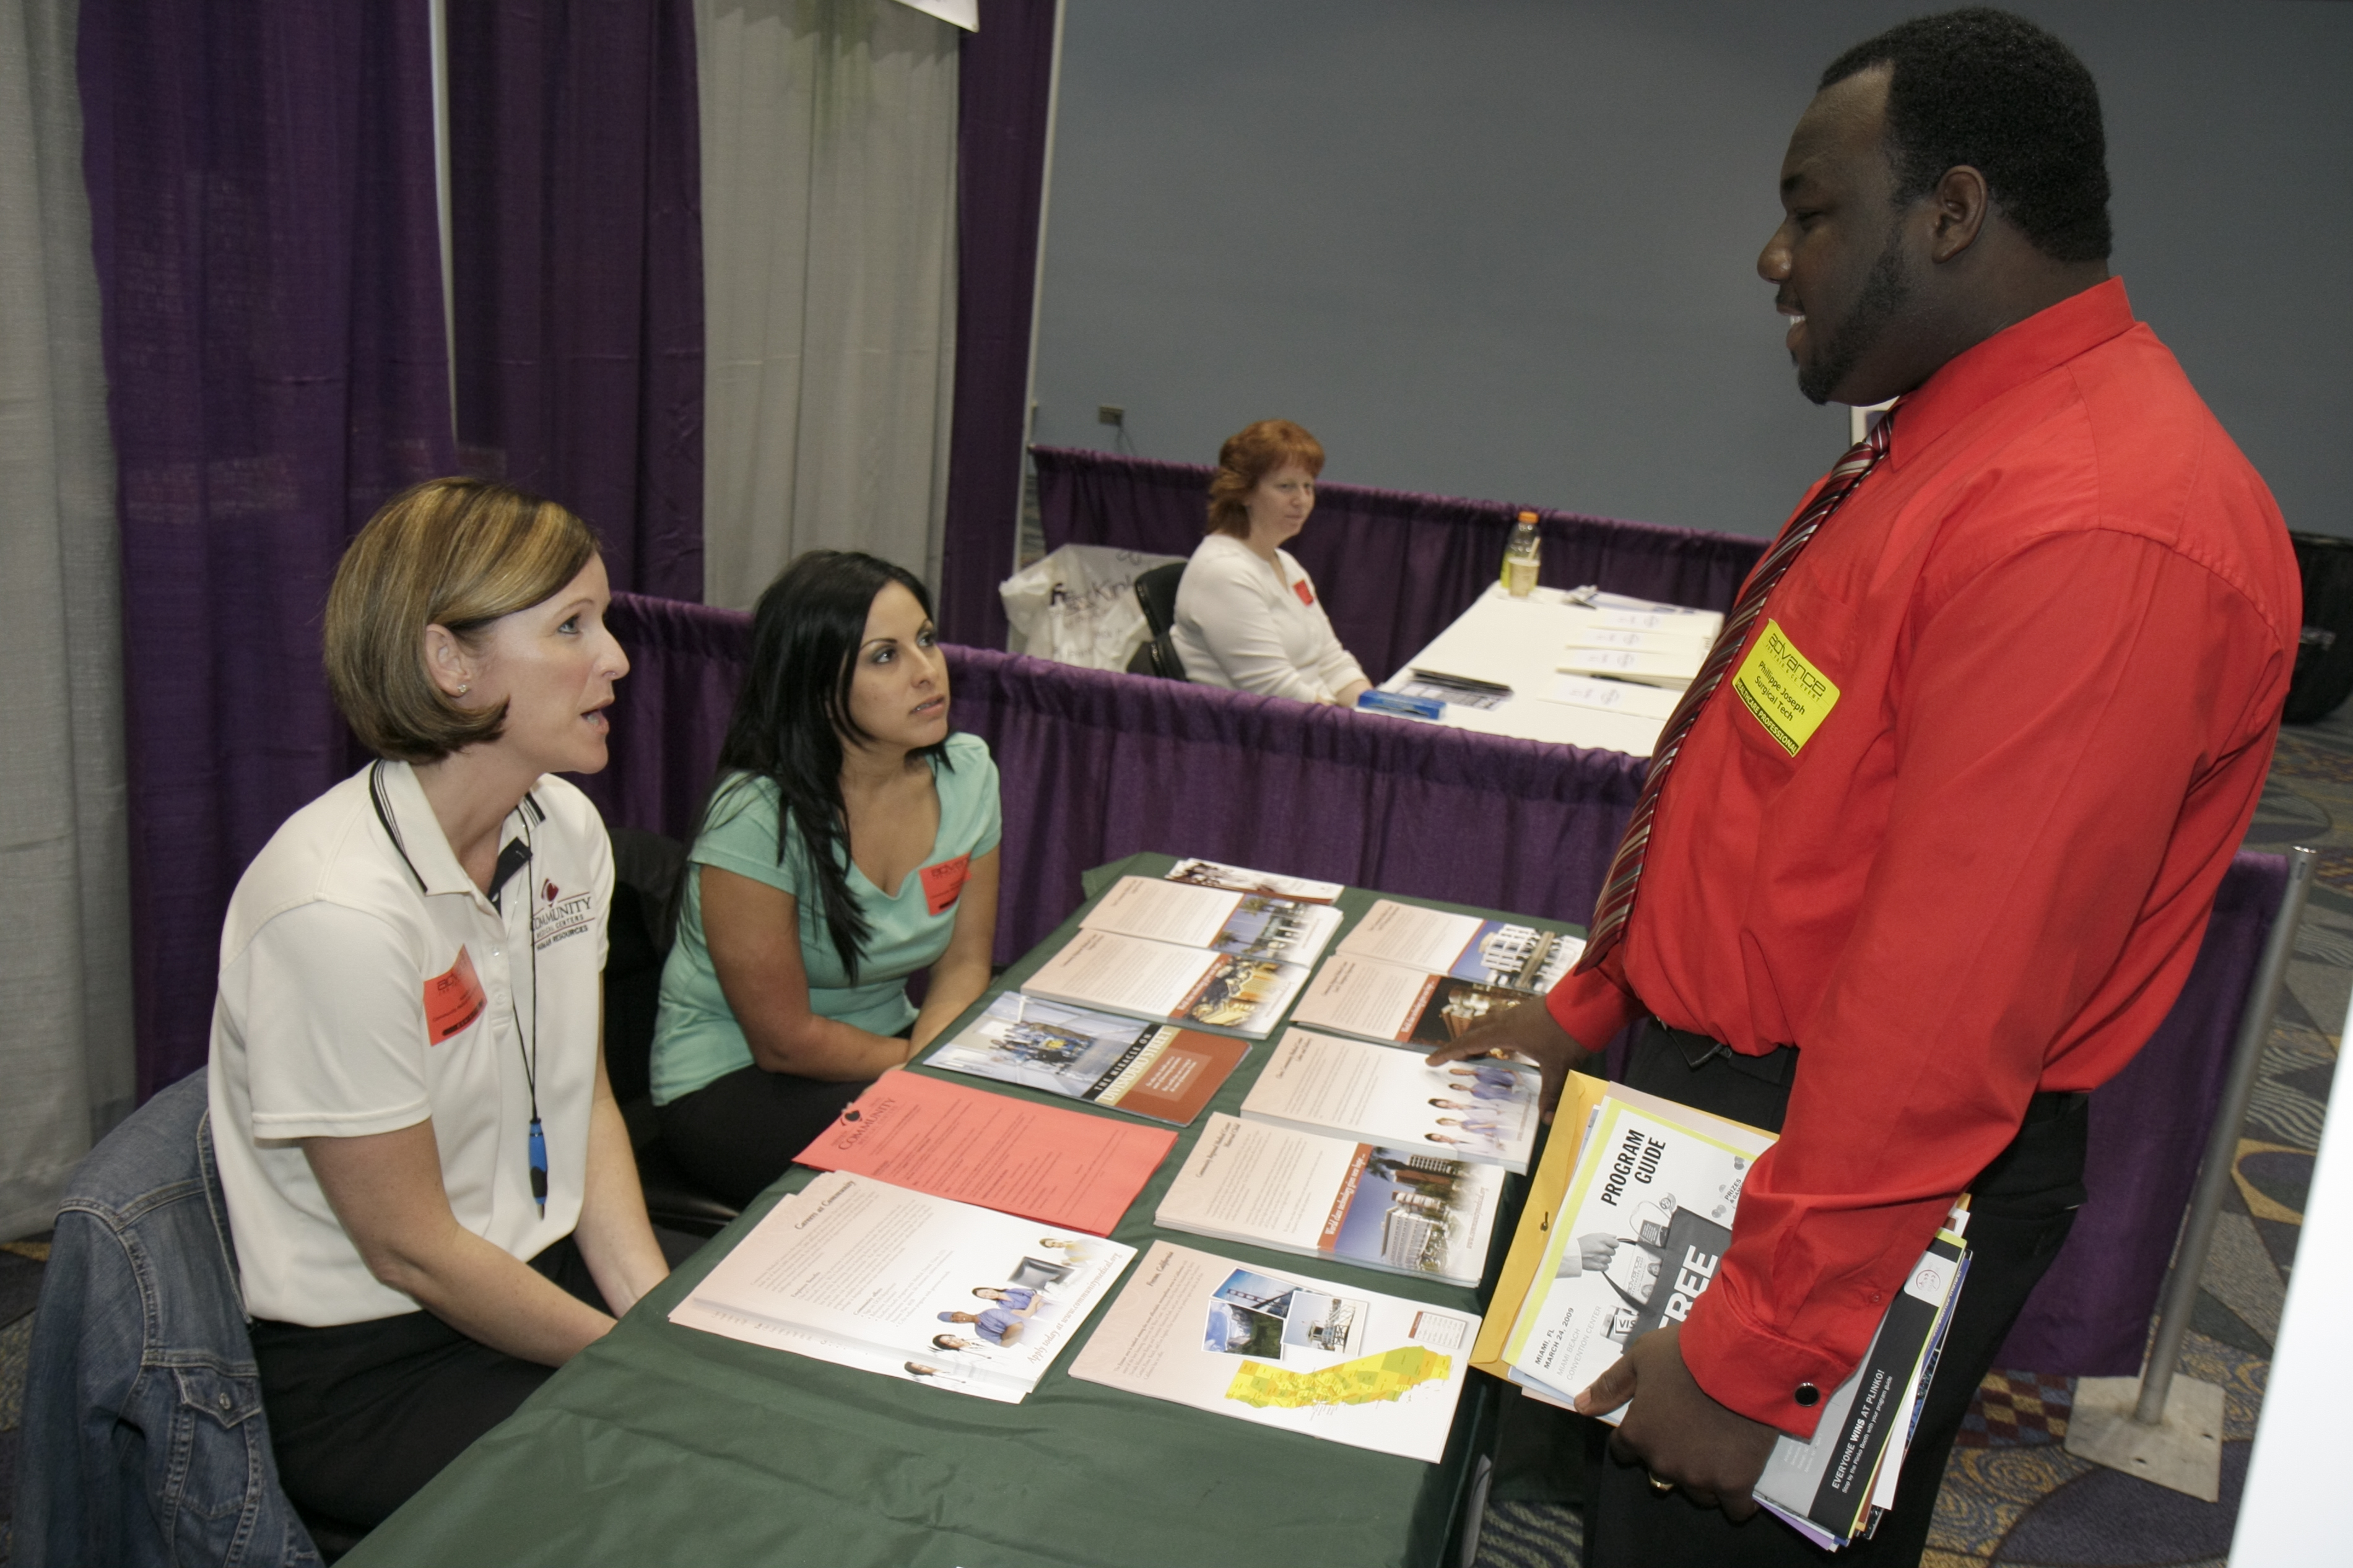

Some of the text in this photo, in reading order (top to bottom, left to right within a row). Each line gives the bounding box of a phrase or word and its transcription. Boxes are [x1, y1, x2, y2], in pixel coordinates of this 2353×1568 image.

[1768, 633, 1826, 696] advance
[1773, 654, 1785, 669] FAIR
[1791, 674, 1798, 683] CE
[1800, 682, 1820, 703] EVENT
[1736, 680, 1798, 754] HEALTHCARE PROFESSIONAL
[1755, 675, 1793, 721] Surgical Tech
[1781, 687, 1806, 716] Joseph
[552, 925, 588, 942] RESOURCES
[1093, 1033, 1154, 1091] THE MIRACLE ON
[1099, 1055, 1149, 1101] DIVISADERO
[1139, 1029, 1173, 1057] STREET
[837, 1097, 897, 1150] COMMUNITY
[1230, 1123, 1240, 1132] Child
[1344, 1176, 1359, 1188] gives
[1350, 1167, 1359, 1177] new
[1601, 1128, 1645, 1206] PROGRAM
[1634, 1137, 1666, 1185] GUIDE
[793, 1211, 819, 1230] Careers
[819, 1179, 857, 1207] Community
[1335, 1186, 1355, 1210] technology
[1724, 1177, 1741, 1200] PRIZES
[1324, 1219, 1339, 1235] World
[1331, 1208, 1343, 1221] class
[1146, 1250, 1176, 1286] Fresno, California
[853, 1297, 874, 1315] Community
[1025, 1345, 1048, 1364] Apply
[1039, 1329, 1061, 1346] today
[1059, 1251, 1123, 1324] www.communitymedical.org
[1534, 1327, 1554, 1365] MIAMI, FL
[1544, 1306, 1574, 1369] MARCH 24, 2009
[1557, 1328, 1580, 1376] MIAMI BEACH
[1566, 1305, 1601, 1381] CONVENTION CENTER
[1831, 1369, 1885, 1489] EVERYONE WINS AT PLINKO!
[1842, 1480, 1850, 1494] Stop
[1846, 1473, 1853, 1481] by
[1853, 1448, 1863, 1465] Plinko
[1859, 1432, 1869, 1449] Booth
[1865, 1421, 1874, 1434] with
[1871, 1410, 1879, 1423] your
[1876, 1390, 1888, 1411] program
[1882, 1375, 1894, 1390] guide
